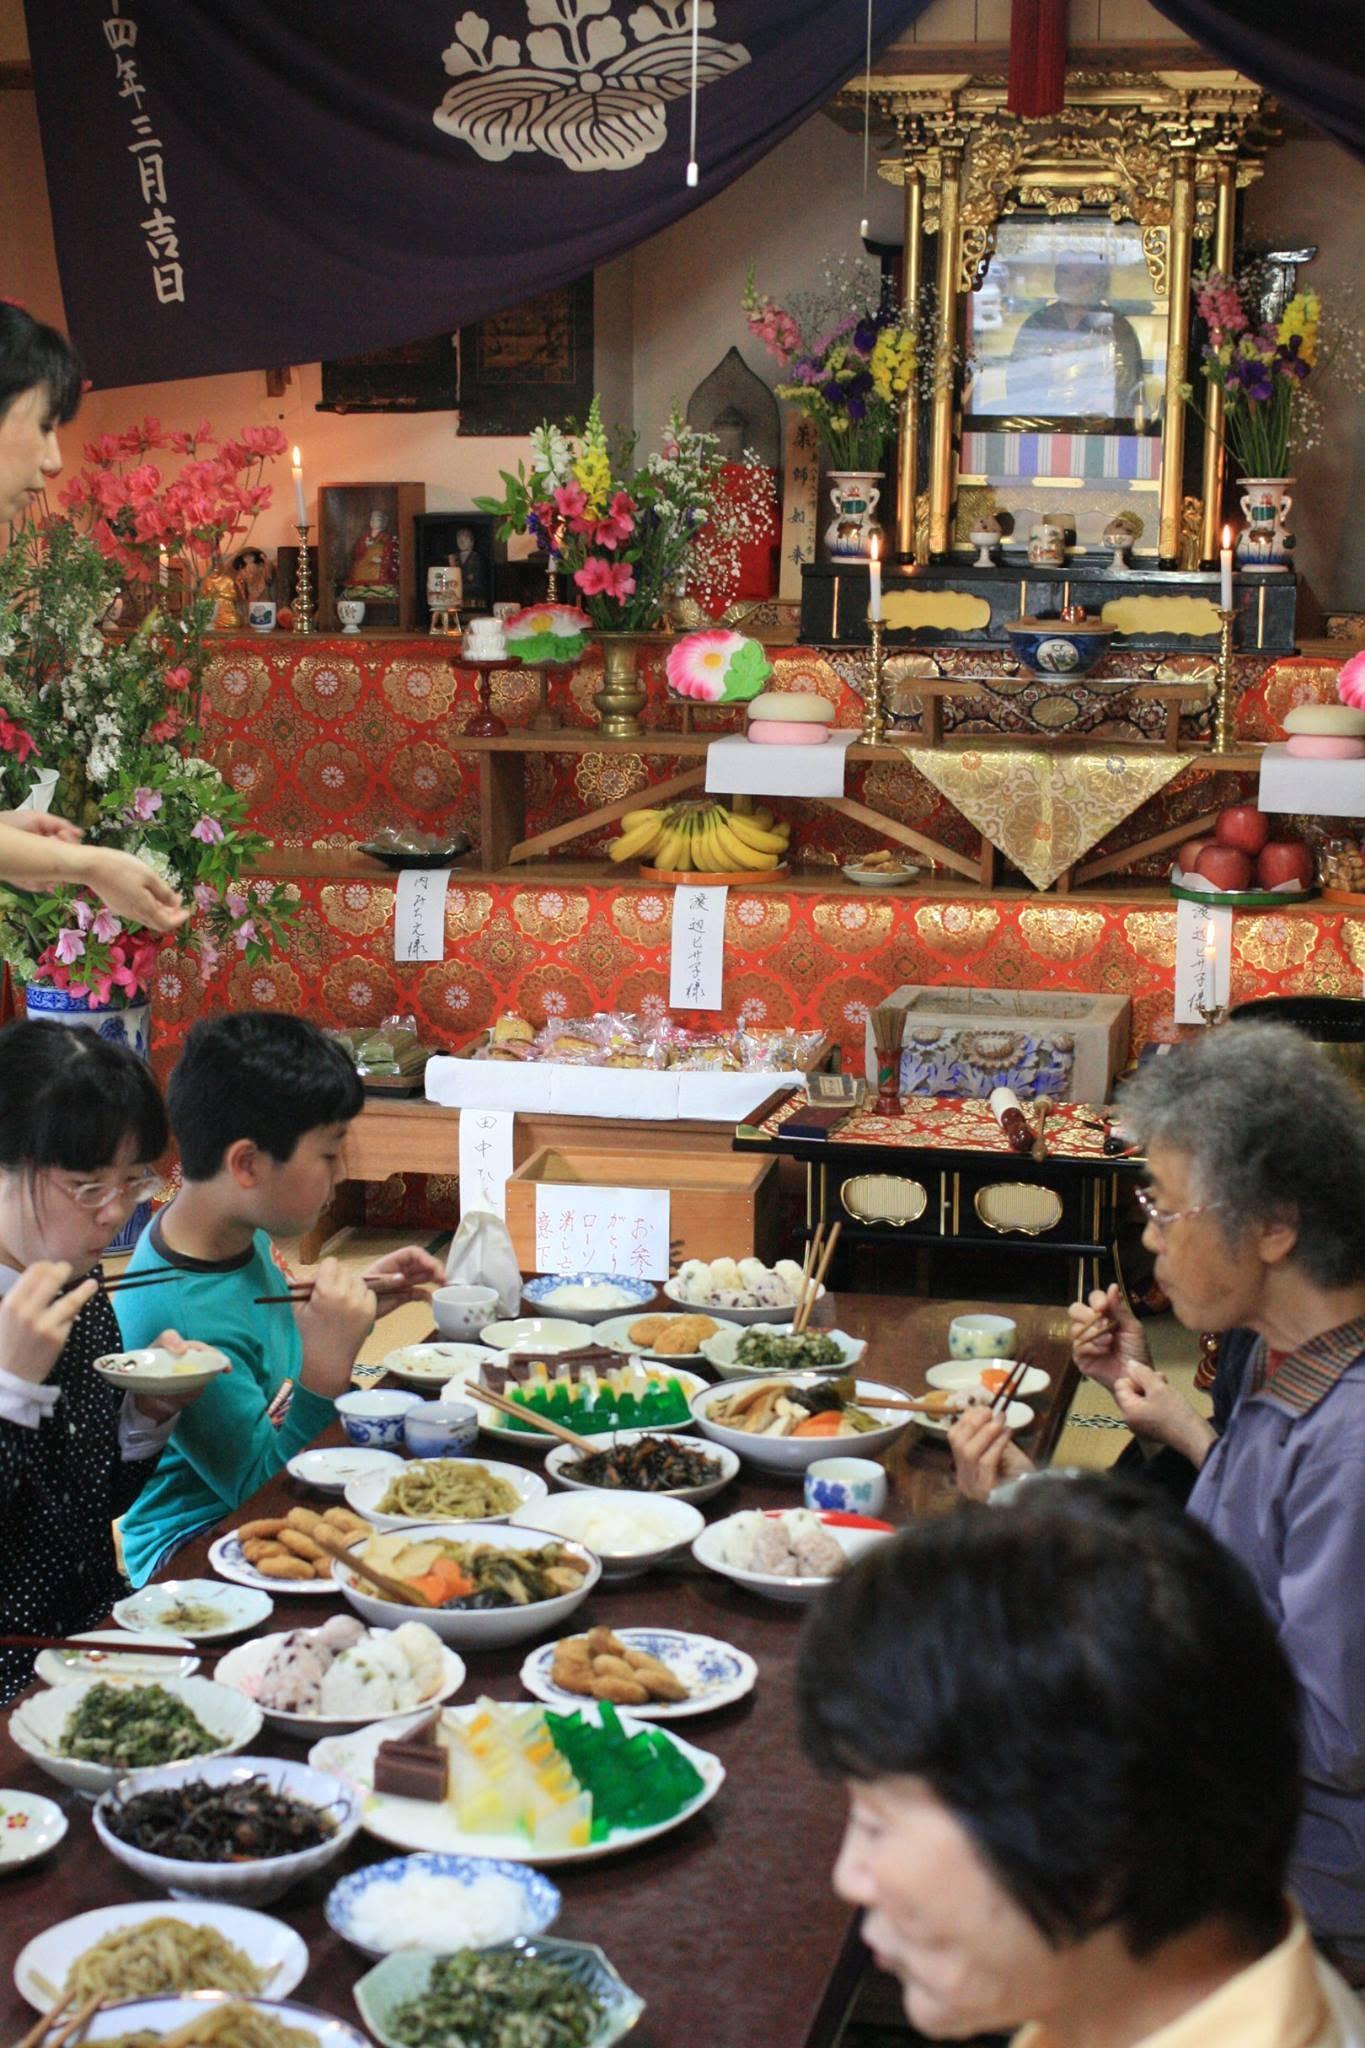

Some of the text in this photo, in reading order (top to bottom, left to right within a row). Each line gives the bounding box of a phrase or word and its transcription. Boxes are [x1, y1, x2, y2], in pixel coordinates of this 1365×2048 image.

[408, 868, 428, 960] 内みちえ様
